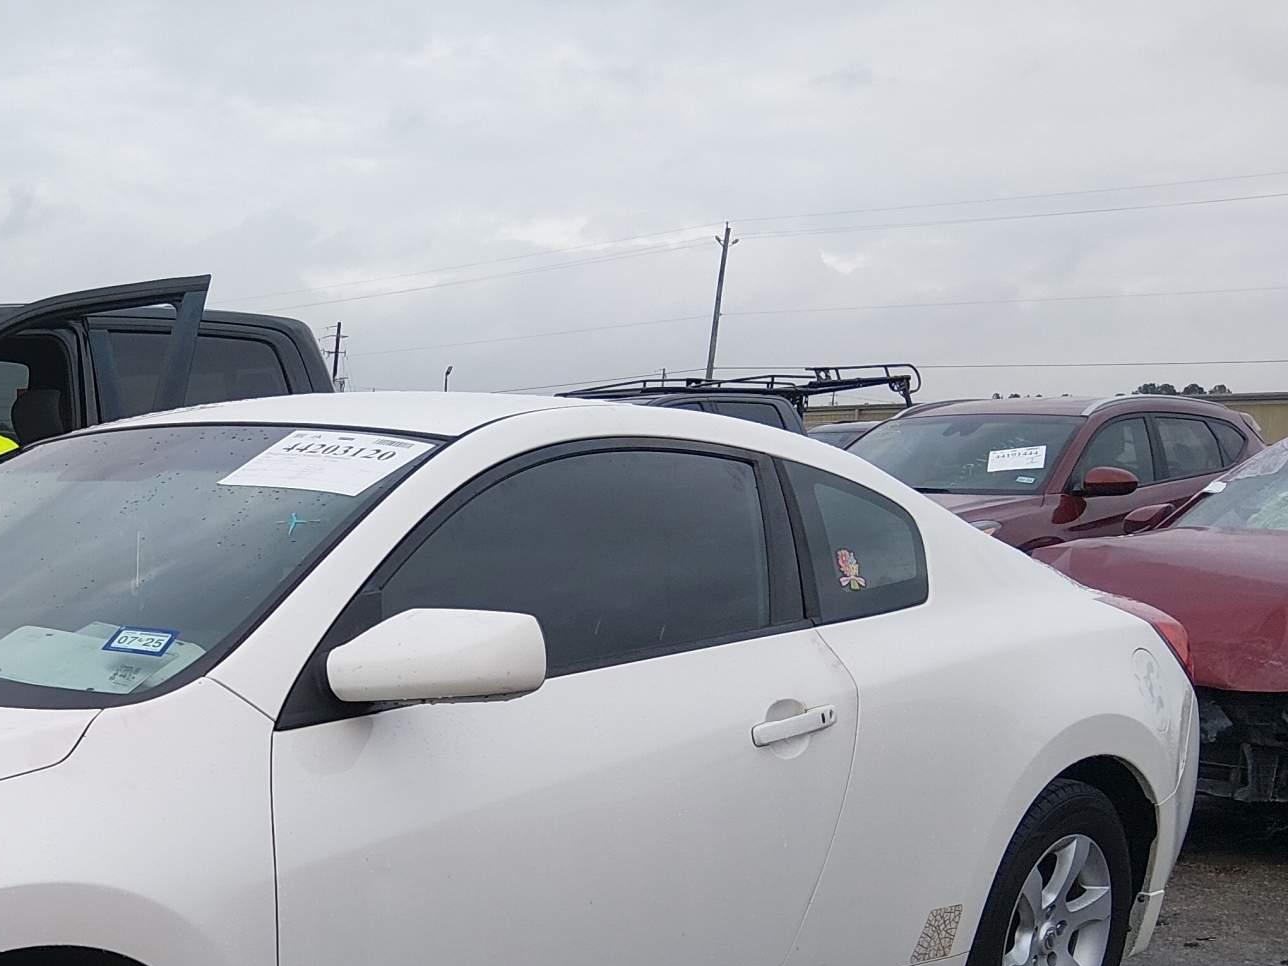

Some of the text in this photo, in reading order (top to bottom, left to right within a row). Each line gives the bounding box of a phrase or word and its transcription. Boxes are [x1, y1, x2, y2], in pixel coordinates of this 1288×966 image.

[282, 442, 397, 461] 44203120
[117, 635, 165, 648] 07 25
